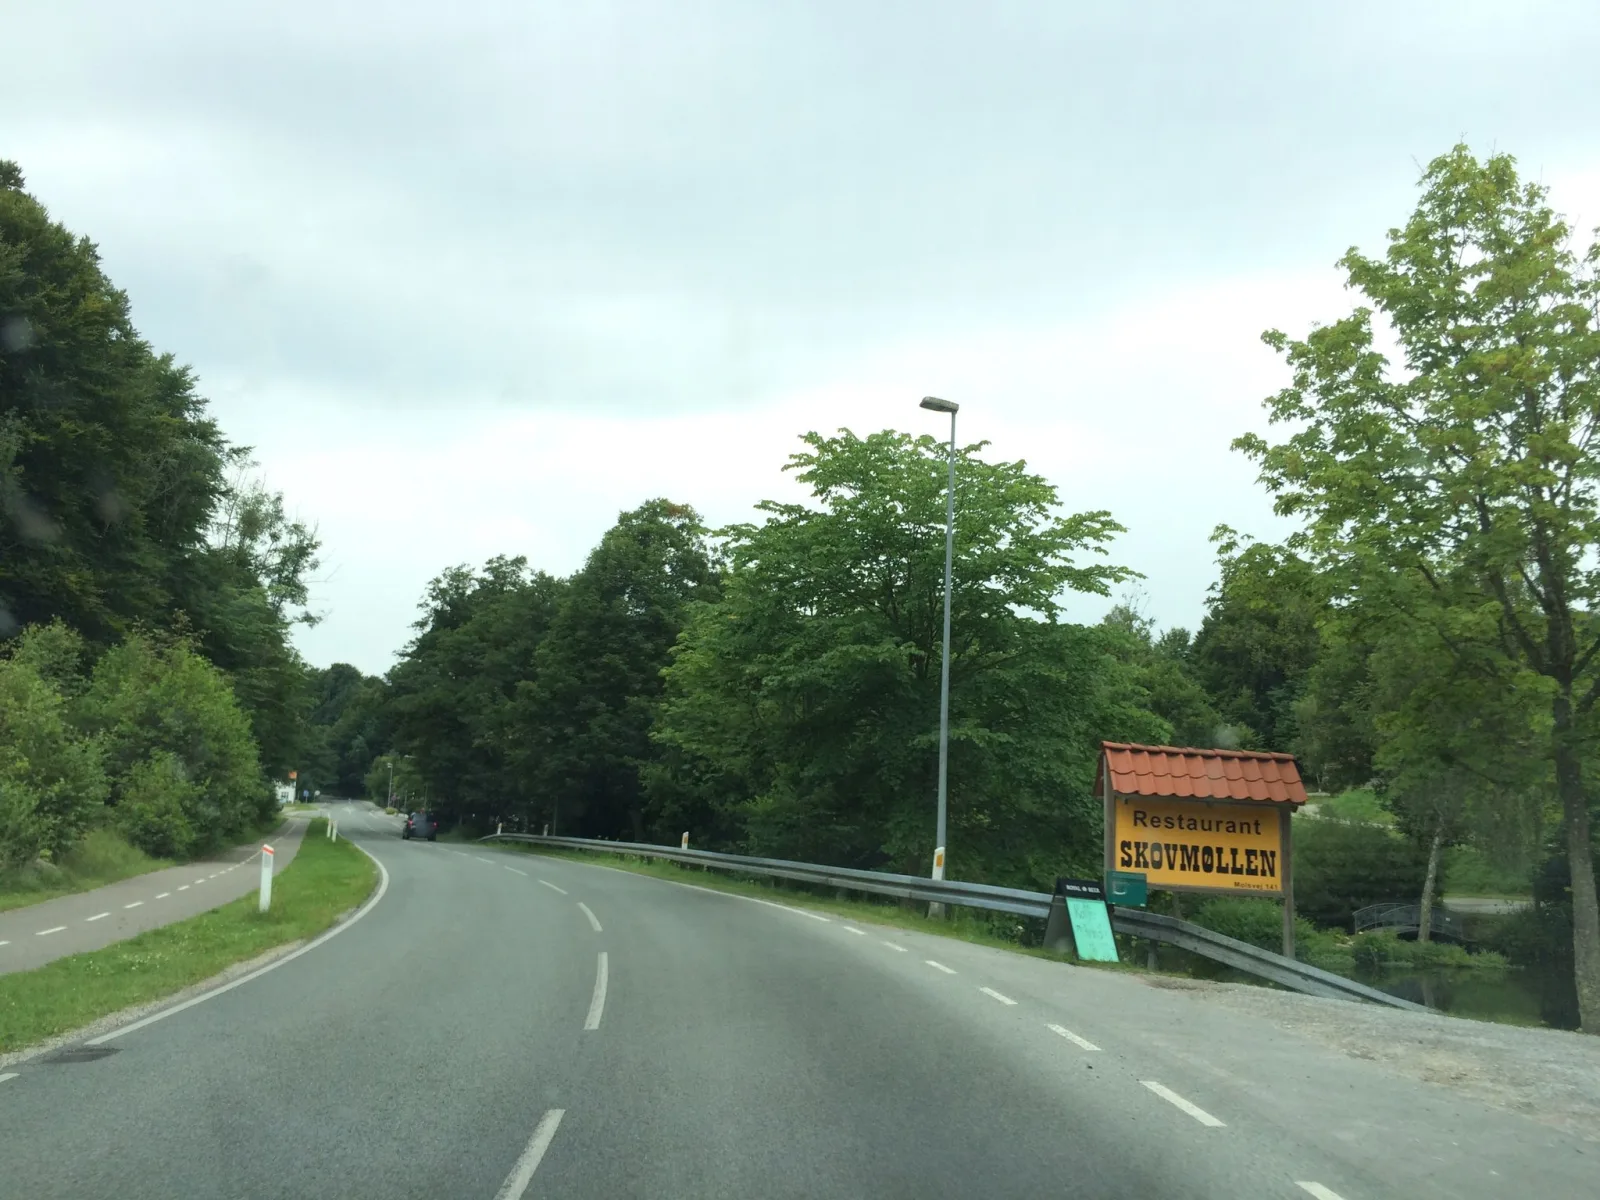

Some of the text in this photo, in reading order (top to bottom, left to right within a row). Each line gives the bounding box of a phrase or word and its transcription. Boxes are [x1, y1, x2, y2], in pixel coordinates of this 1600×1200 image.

[1133, 810, 1261, 835] Restaurant
[1120, 840, 1276, 877] SKOVMØLLEN
[1233, 881, 1263, 890] Molsvej
